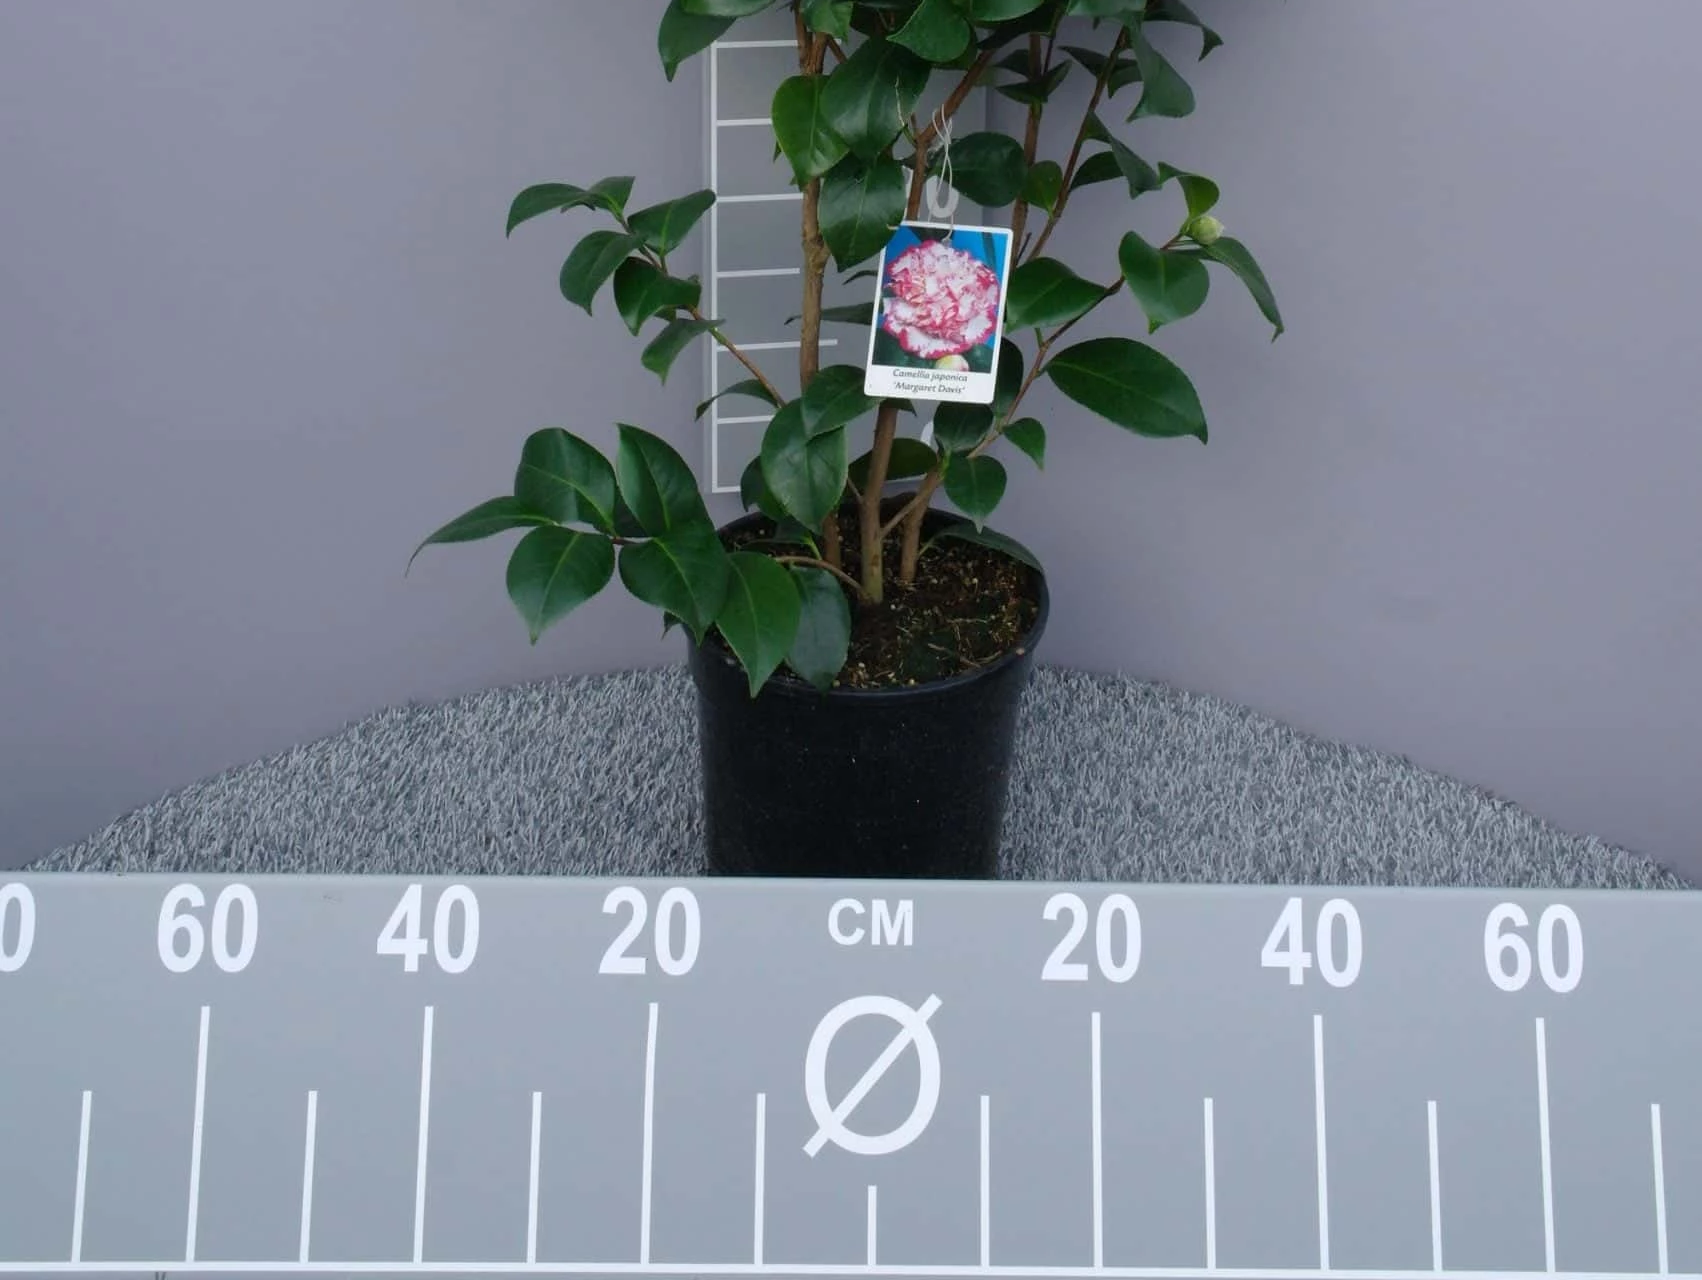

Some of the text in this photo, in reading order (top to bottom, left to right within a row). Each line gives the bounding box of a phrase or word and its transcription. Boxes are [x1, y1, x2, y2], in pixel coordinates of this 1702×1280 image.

[892, 368, 968, 382] Camellia japonica
[158, 883, 258, 972] 60
[377, 884, 479, 973] 40
[599, 886, 700, 975] 20
[829, 899, 913, 946] CM
[1042, 893, 1141, 982] 20
[1262, 897, 1362, 987] 40
[1485, 903, 1583, 992] 60
